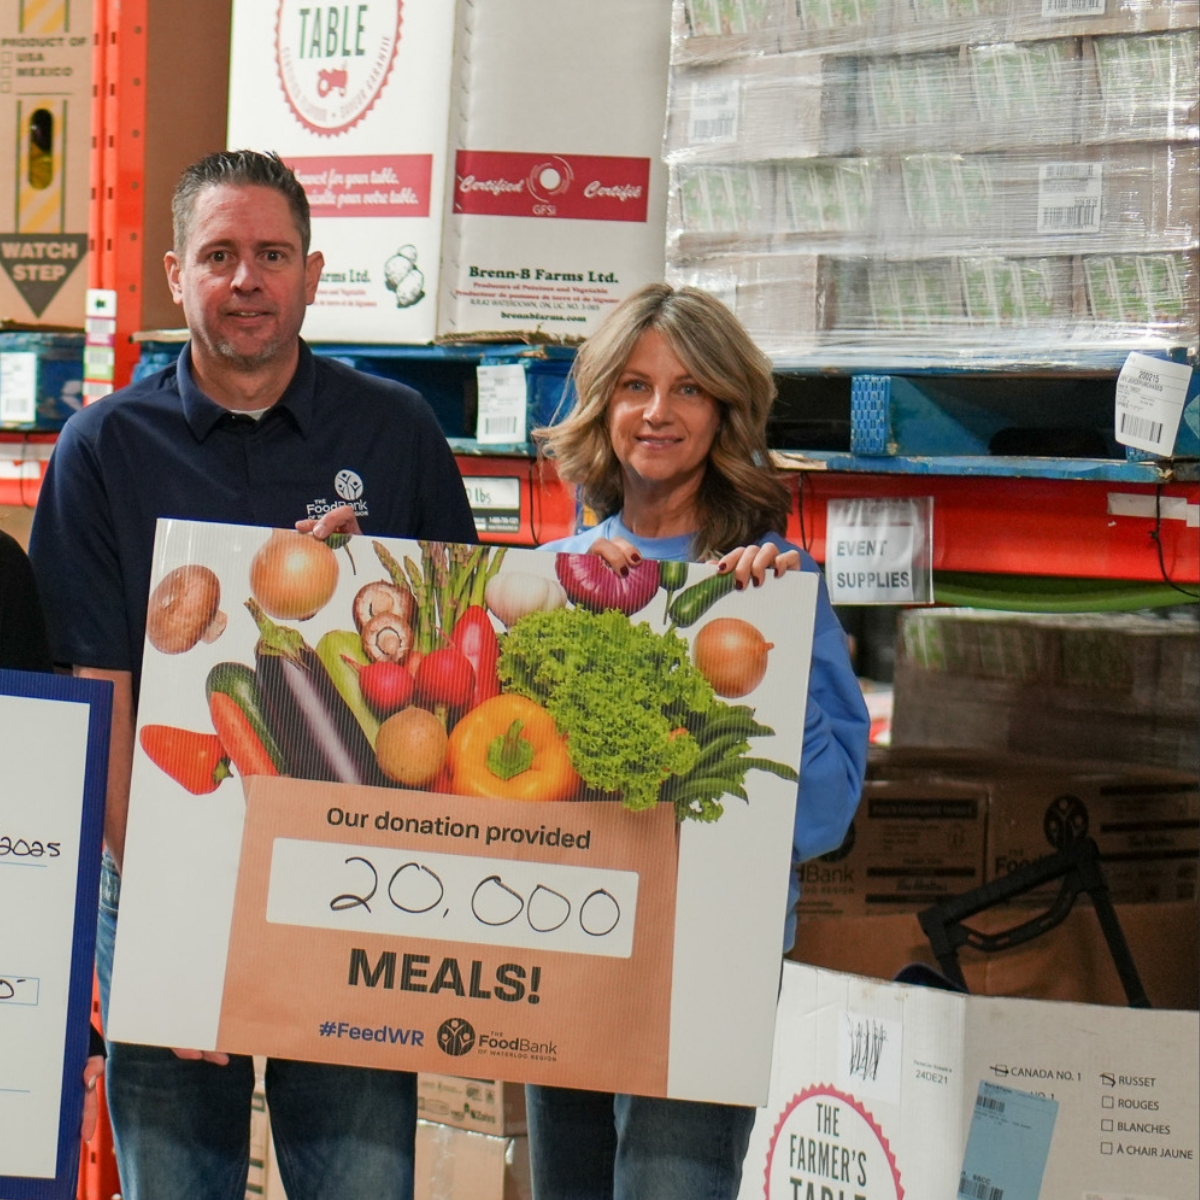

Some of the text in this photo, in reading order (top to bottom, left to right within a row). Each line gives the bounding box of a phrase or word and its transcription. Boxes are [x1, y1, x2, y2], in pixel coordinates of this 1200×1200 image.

[299, 4, 368, 59] TABLE
[1, 37, 88, 48] PRODUCT OF
[16, 53, 45, 63] USA
[16, 67, 74, 78] MEXICO
[460, 175, 525, 196] Certified
[1, 242, 78, 260] WATCH
[13, 264, 67, 282] STEP
[319, 269, 372, 283] arms Ltd.
[469, 265, 619, 283] Brenn-B Farms Ltd.
[836, 540, 888, 557] EVENT
[836, 571, 910, 588] SUPPLIES
[326, 806, 591, 850] Our donation provided
[329, 856, 621, 937] 20,000
[348, 947, 542, 1005] MEALS!
[319, 1020, 425, 1048] #FeedWR
[478, 1033, 558, 1055] FoodBank
[490, 1049, 529, 1060] WATERLOO
[530, 1053, 558, 1062] REGION
[915, 1068, 949, 1085] 24DE21
[1011, 1066, 1082, 1082] CANADA NO. 1
[1118, 1075, 1157, 1087] RUSSET
[1118, 1098, 1160, 1111] ROUGES
[816, 1102, 840, 1137] THE
[1117, 1121, 1171, 1135] BLANCHES
[789, 1133, 867, 1187] FARMER'S
[1116, 1142, 1194, 1160] À CHAIR JAUNE
